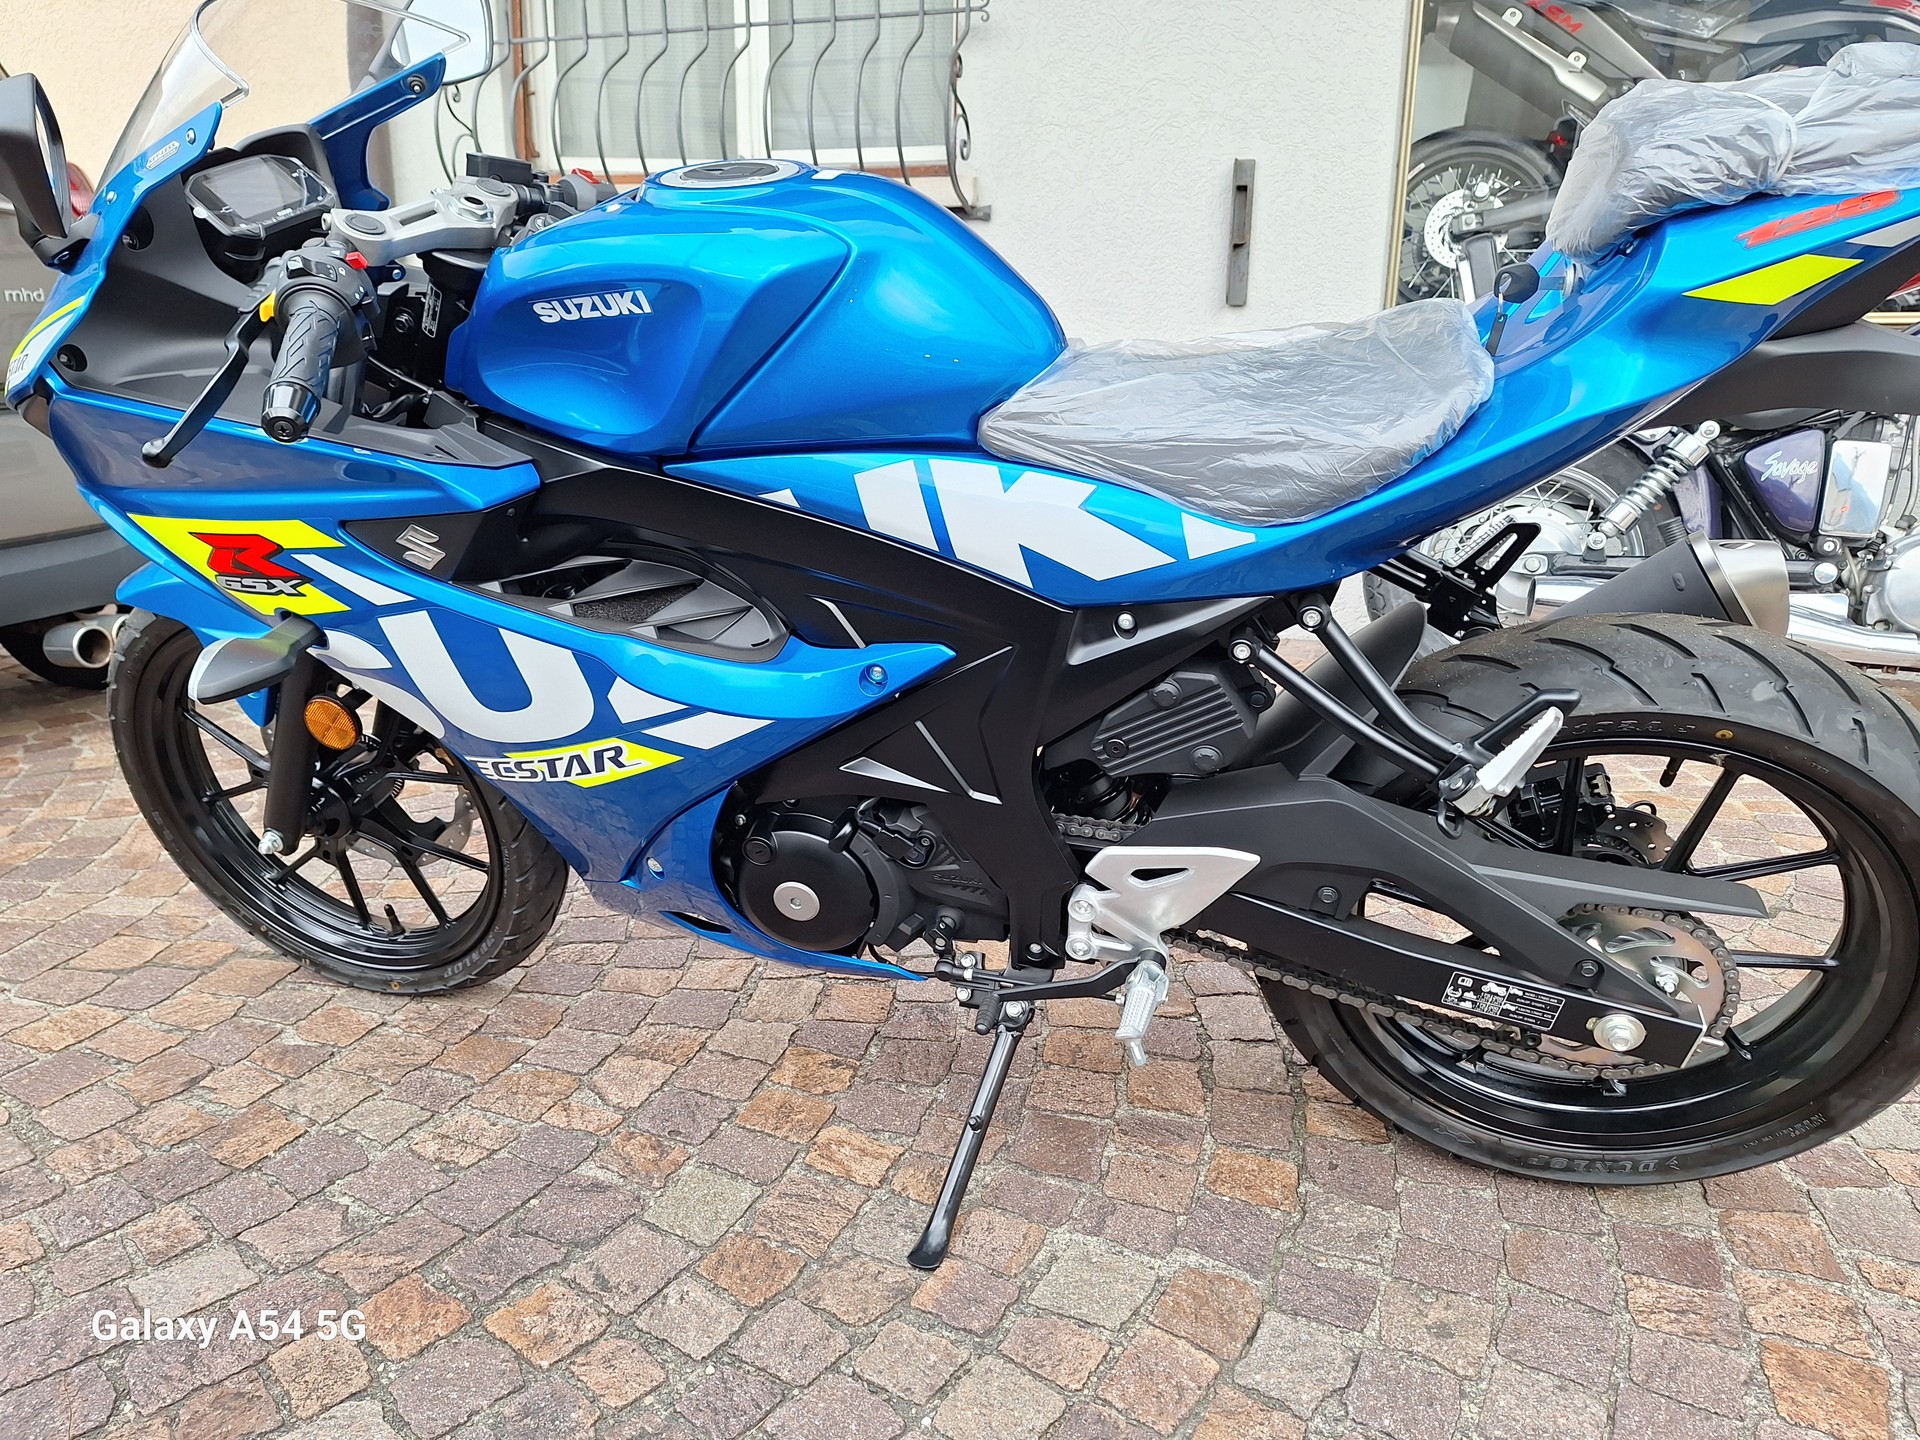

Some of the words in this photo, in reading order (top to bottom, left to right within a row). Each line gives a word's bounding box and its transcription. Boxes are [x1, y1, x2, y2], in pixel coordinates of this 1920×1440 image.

[1737, 189, 1899, 247] 125
[3, 287, 45, 303] mhd
[532, 290, 652, 323] SUZUKI
[1761, 450, 1819, 484] Savage
[215, 575, 306, 596] GSX
[468, 745, 643, 782] ECSTAR
[1527, 1154, 1660, 1174] DUNLOP
